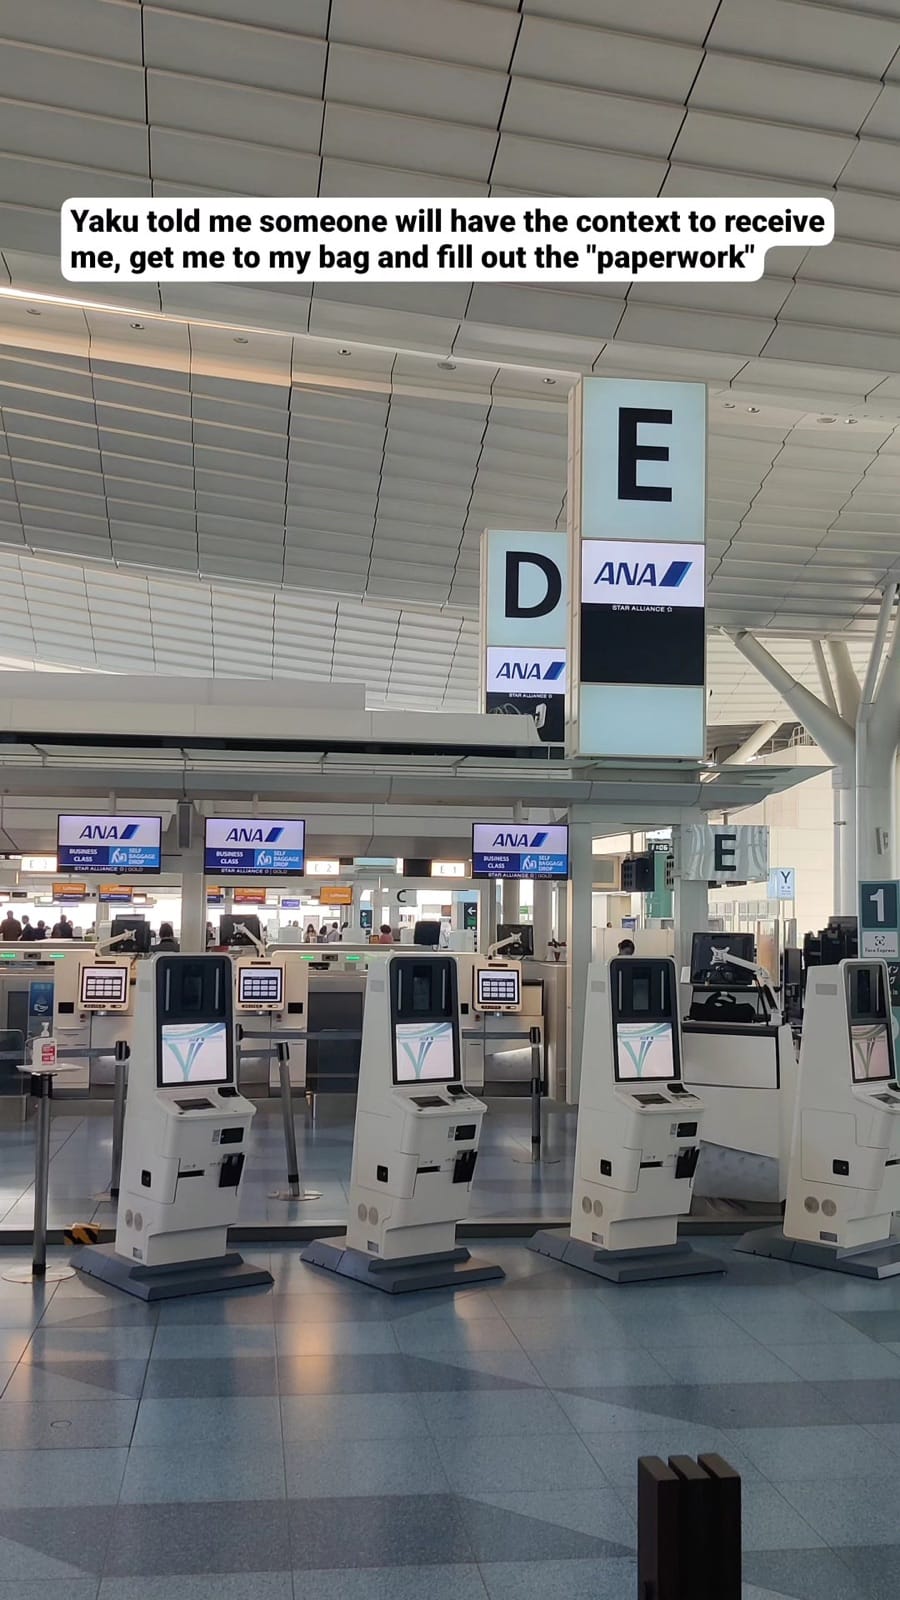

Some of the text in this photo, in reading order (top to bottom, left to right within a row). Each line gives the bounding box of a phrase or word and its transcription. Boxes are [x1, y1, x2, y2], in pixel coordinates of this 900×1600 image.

[617, 406, 673, 503] E
[593, 561, 657, 586] ANA
[504, 550, 562, 619] D
[496, 662, 541, 680] ANA
[79, 825, 118, 840] ANA
[225, 828, 263, 842] ANA
[492, 833, 529, 847] ANA
[714, 833, 737, 872] E
[780, 870, 791, 884] Y
[869, 888, 885, 922] 1
